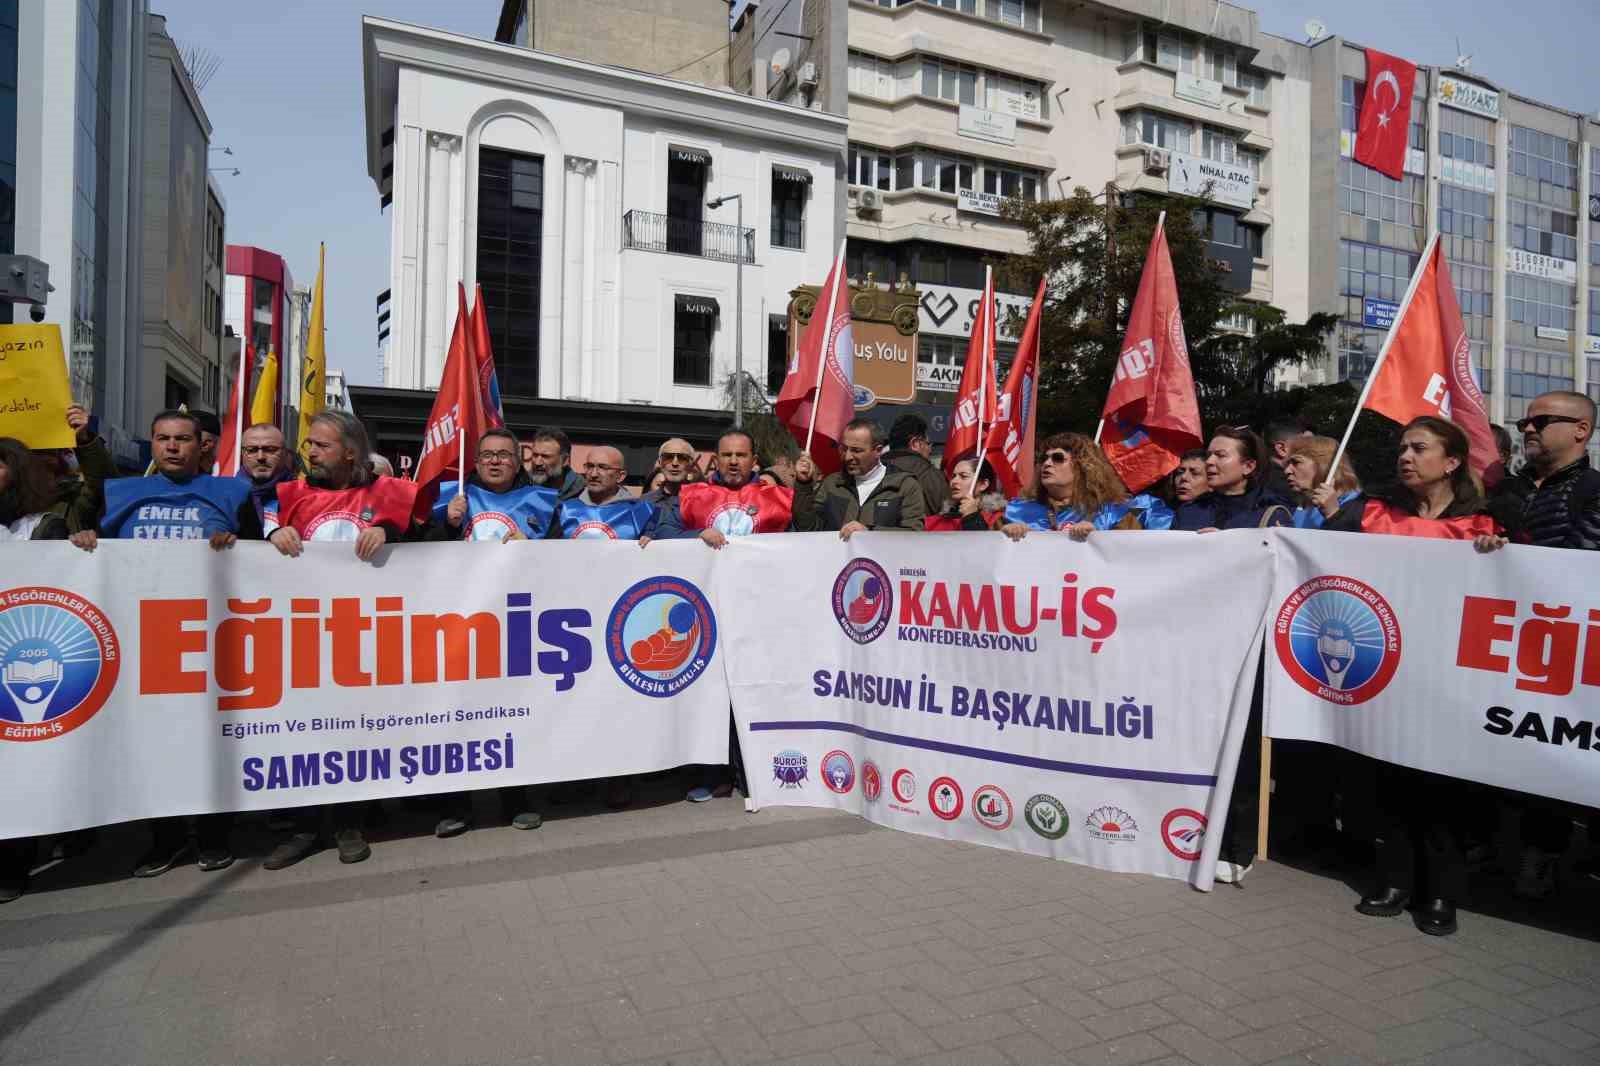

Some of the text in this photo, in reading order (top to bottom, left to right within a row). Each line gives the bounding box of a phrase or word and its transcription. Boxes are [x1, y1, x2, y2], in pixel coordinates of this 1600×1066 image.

[875, 341, 907, 362] Yolu
[138, 506, 200, 521] EMEK
[133, 525, 204, 540] EYLEM
[899, 572, 1118, 654] KAMU-İŞ
[19, 648, 49, 659] 2005
[898, 626, 1038, 653] KONFEDERASYONU
[813, 669, 1155, 740] SAMSUN İL BAŞKANLIĞI
[221, 706, 531, 740] Eğitim Ve Bilim İşgörenleri Sendikası
[1483, 705, 1600, 752] SAM
[242, 732, 514, 792] SAMSUN ŞUBESİ
